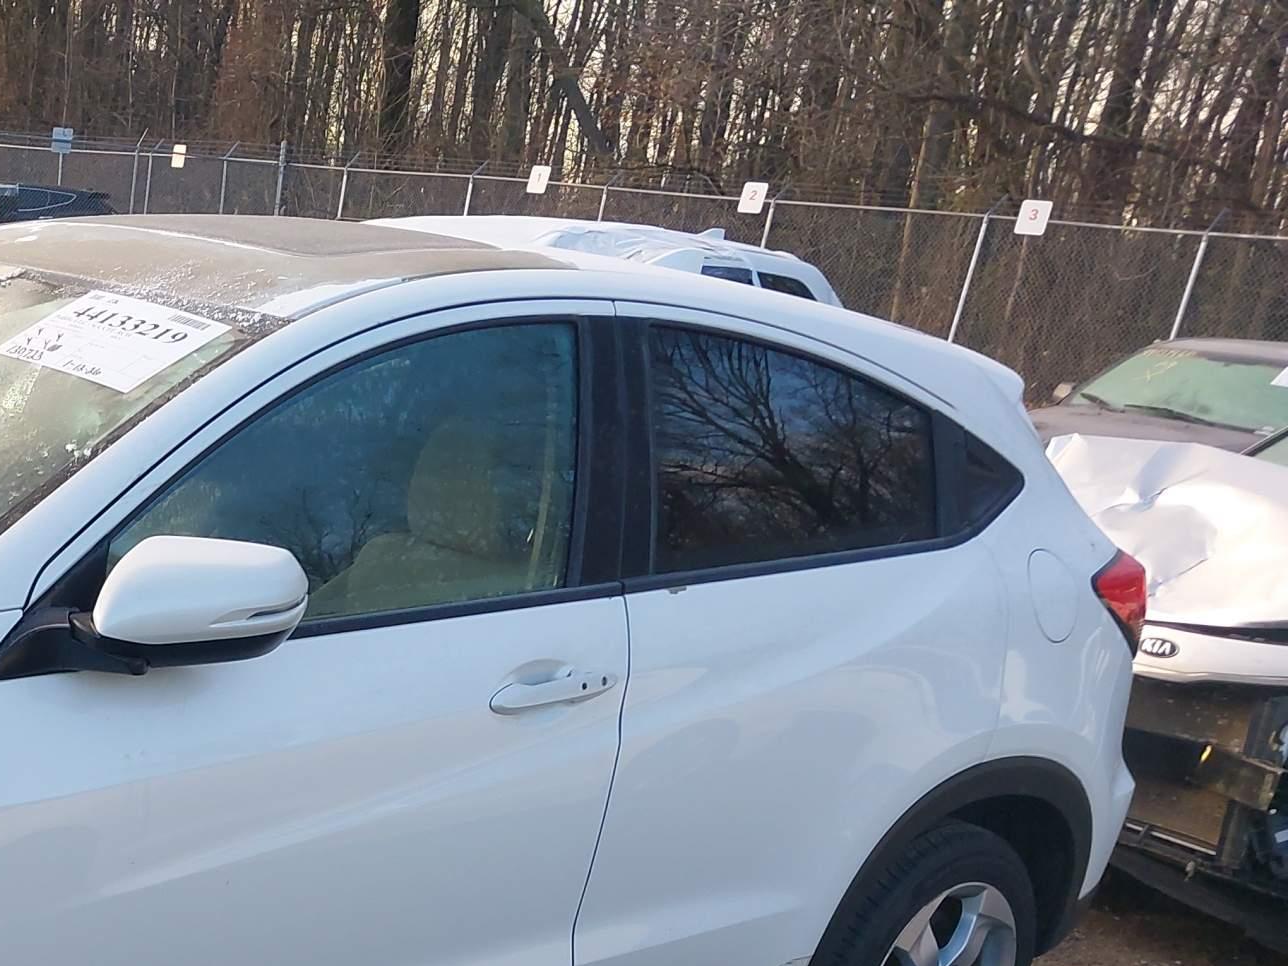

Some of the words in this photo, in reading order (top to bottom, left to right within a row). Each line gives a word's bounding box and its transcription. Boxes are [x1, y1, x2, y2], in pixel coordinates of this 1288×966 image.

[749, 190, 758, 201] 2
[1029, 208, 1039, 221] 3
[72, 306, 188, 344] 44133219
[1141, 639, 1171, 655] KIA
